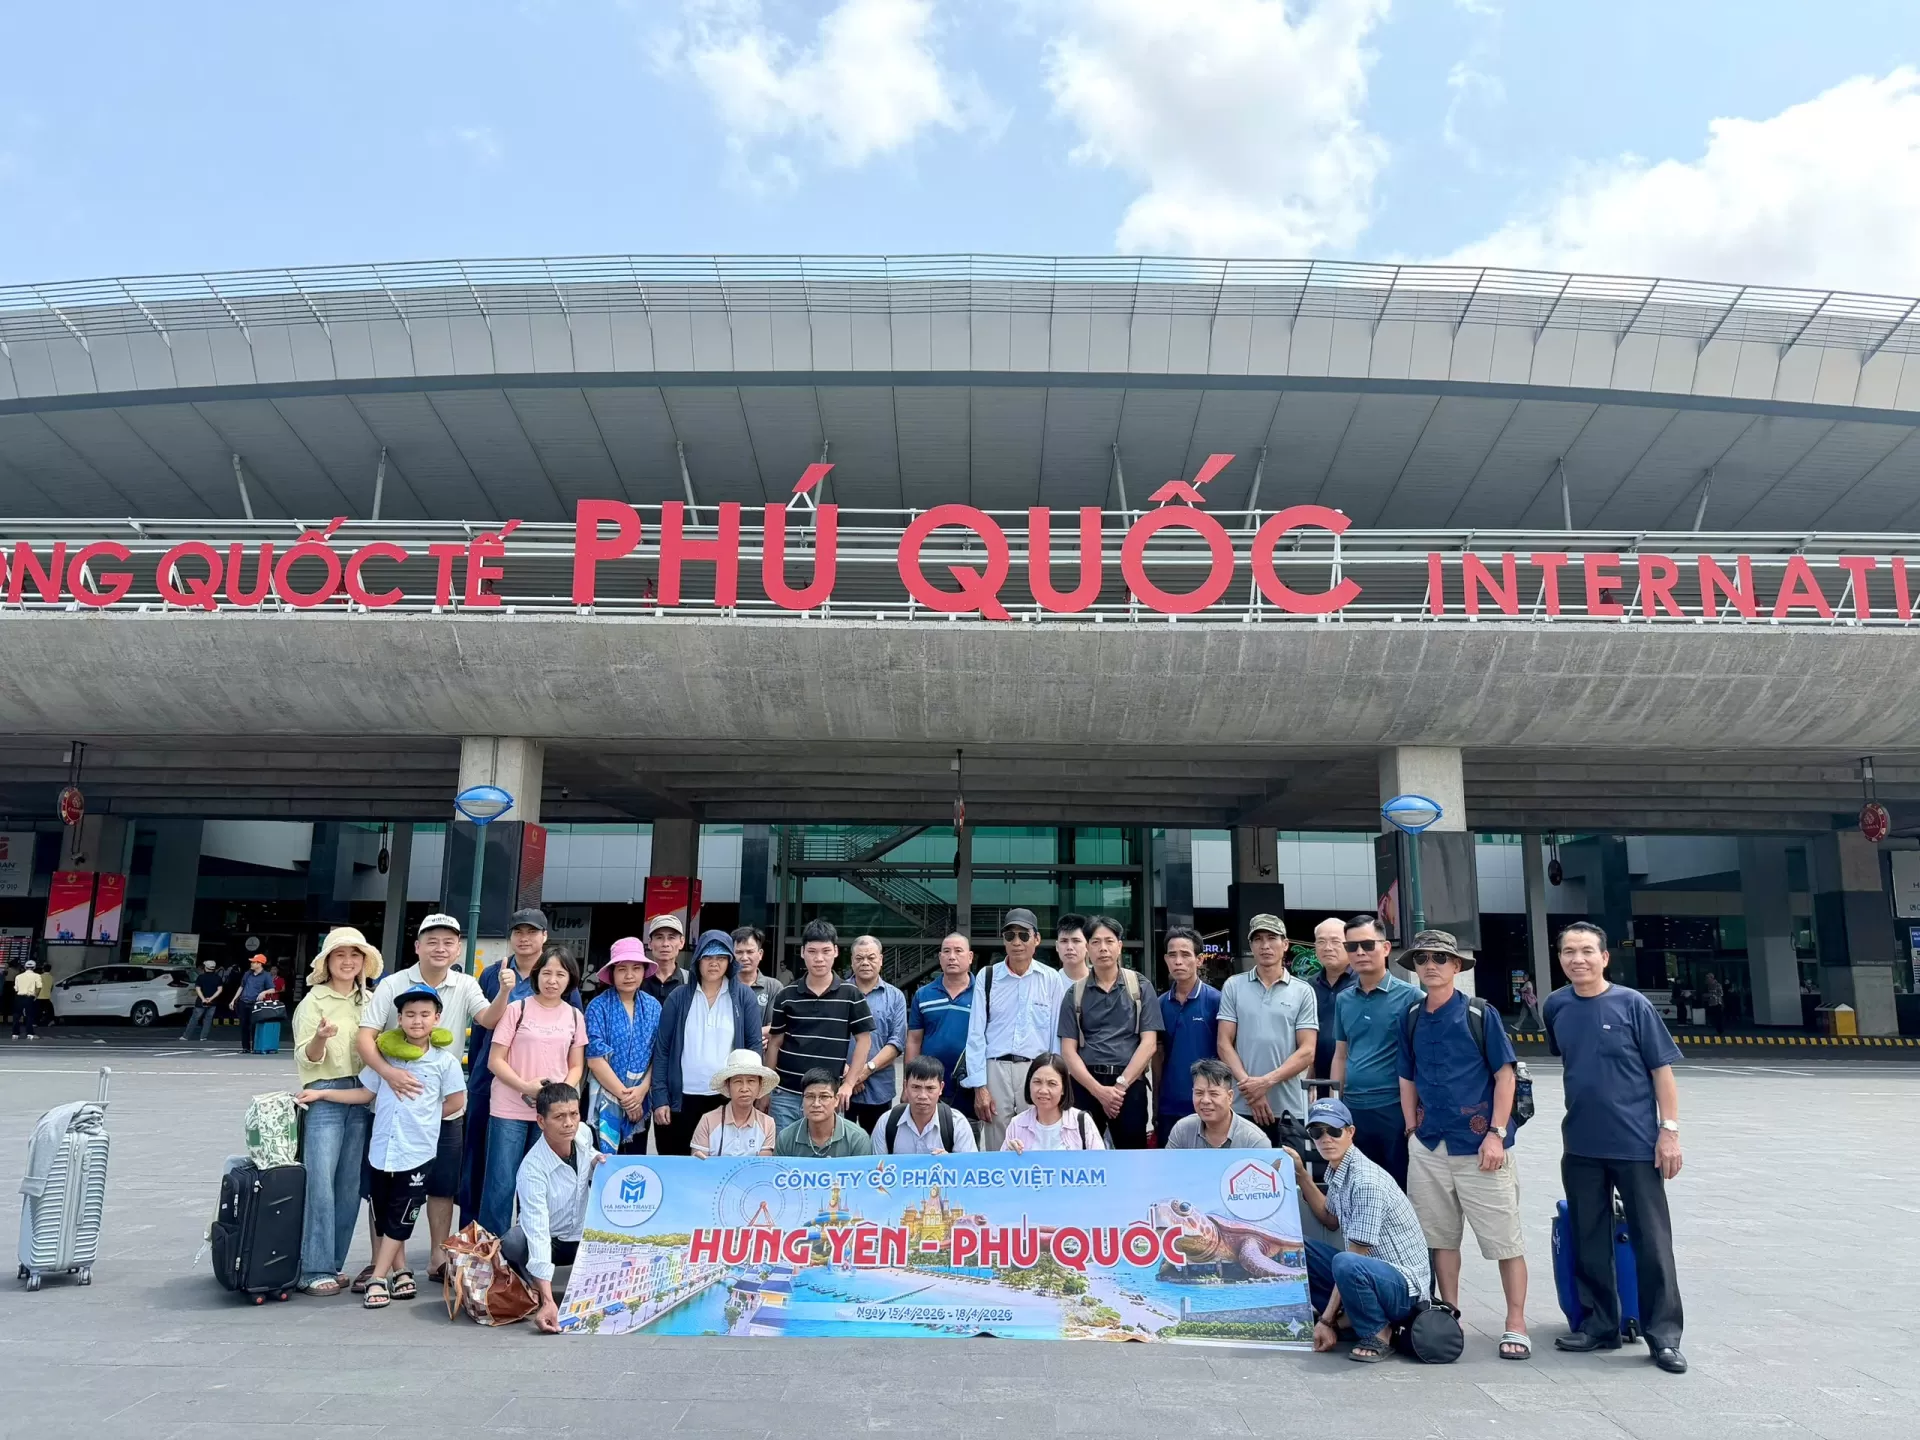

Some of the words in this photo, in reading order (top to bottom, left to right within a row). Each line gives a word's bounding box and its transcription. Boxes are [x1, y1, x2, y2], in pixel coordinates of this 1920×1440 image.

[0, 541, 134, 606] NG
[156, 517, 409, 611] QUỐC
[428, 519, 521, 607] TẾ
[572, 463, 840, 610] PHÚ
[897, 455, 1362, 621] QUỐC
[1428, 554, 1912, 620] INTERNATI
[774, 1169, 831, 1188] CÔNG
[838, 1172, 862, 1187] TY
[868, 1164, 897, 1186] CỔ
[902, 1164, 957, 1185] PHẦN
[963, 1170, 1005, 1186] ABC
[1010, 1165, 1055, 1190] VIỆT
[1061, 1170, 1105, 1186] NAM
[1227, 1193, 1244, 1201] ABC
[1244, 1191, 1281, 1200] VIETNAM
[827, 1221, 909, 1266] YÊN
[953, 1213, 1040, 1267] PHÚ
[1052, 1207, 1186, 1271] QUỐC
[857, 1306, 885, 1320] Ngày
[888, 1306, 945, 1321] 15/4/2026
[955, 1306, 1013, 1321] 18/4/2026
